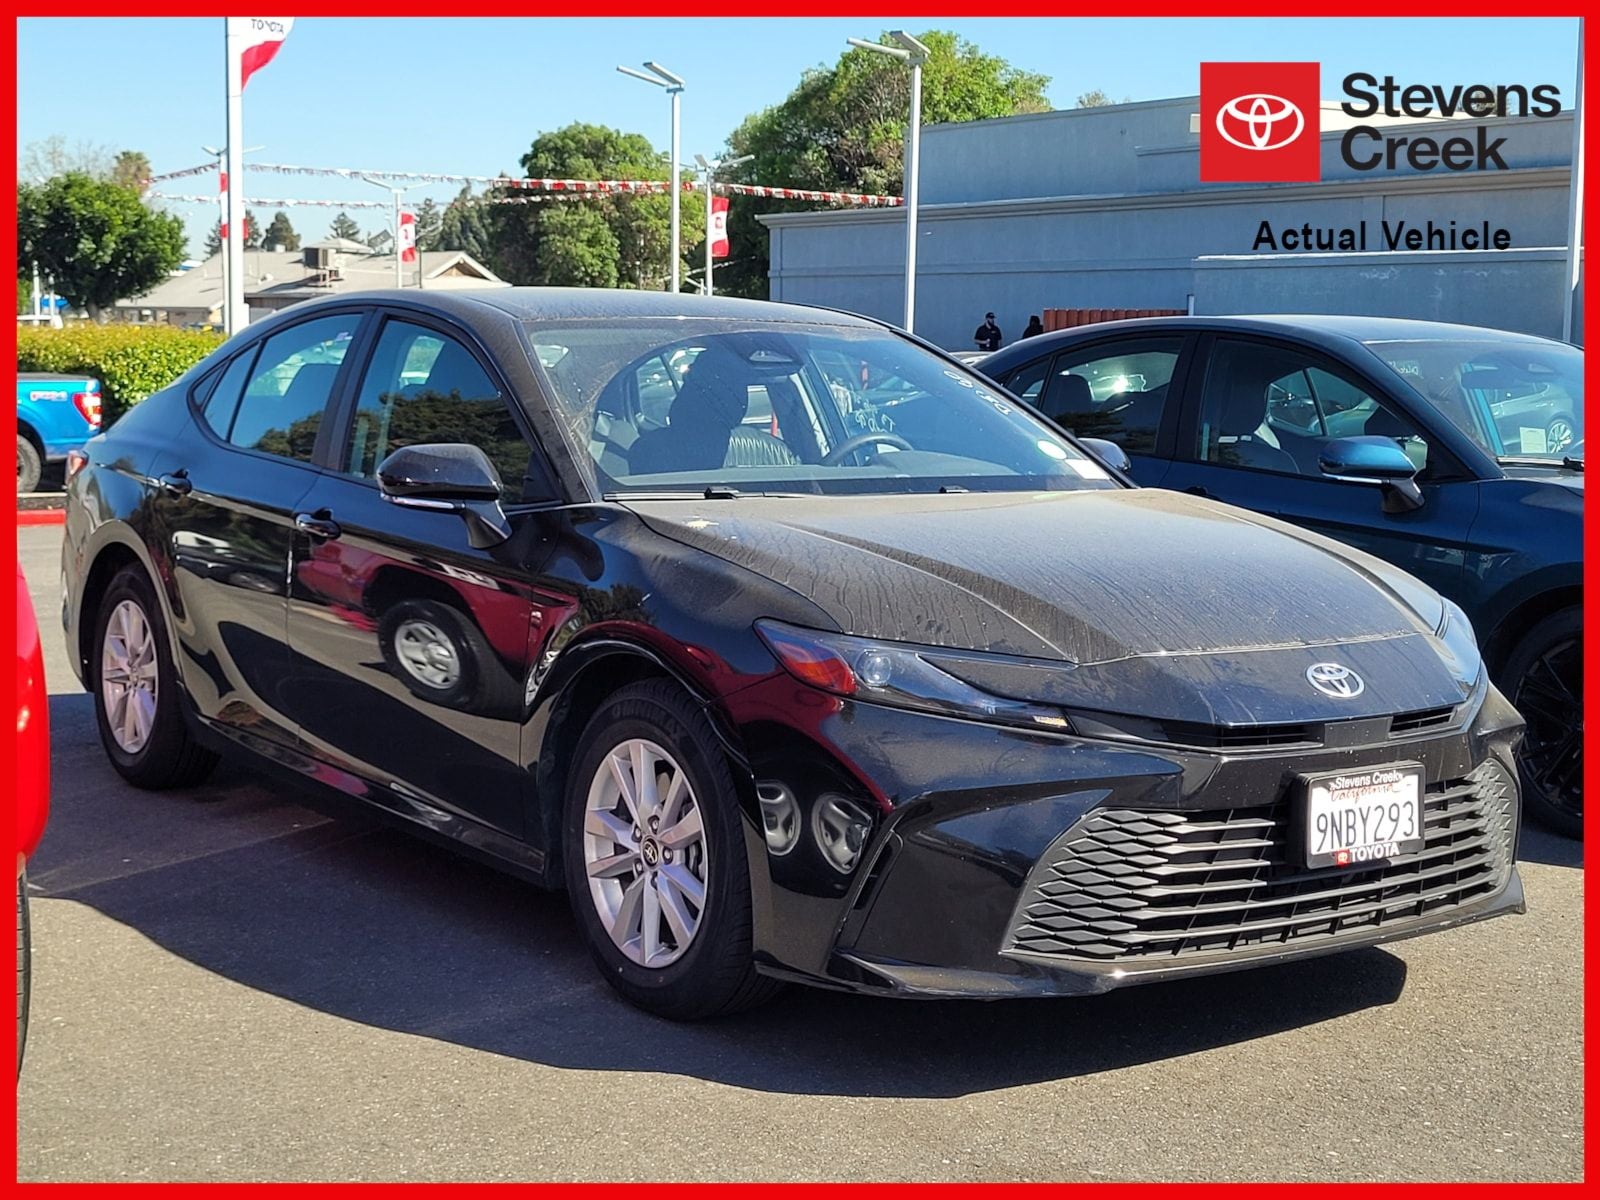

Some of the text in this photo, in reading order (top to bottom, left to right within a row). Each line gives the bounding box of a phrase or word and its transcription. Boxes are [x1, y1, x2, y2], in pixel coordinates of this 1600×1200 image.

[1335, 770, 1402, 789] Stevens Creek
[1316, 801, 1414, 852] 9NBY293
[1350, 842, 1400, 863] TOYOTA
